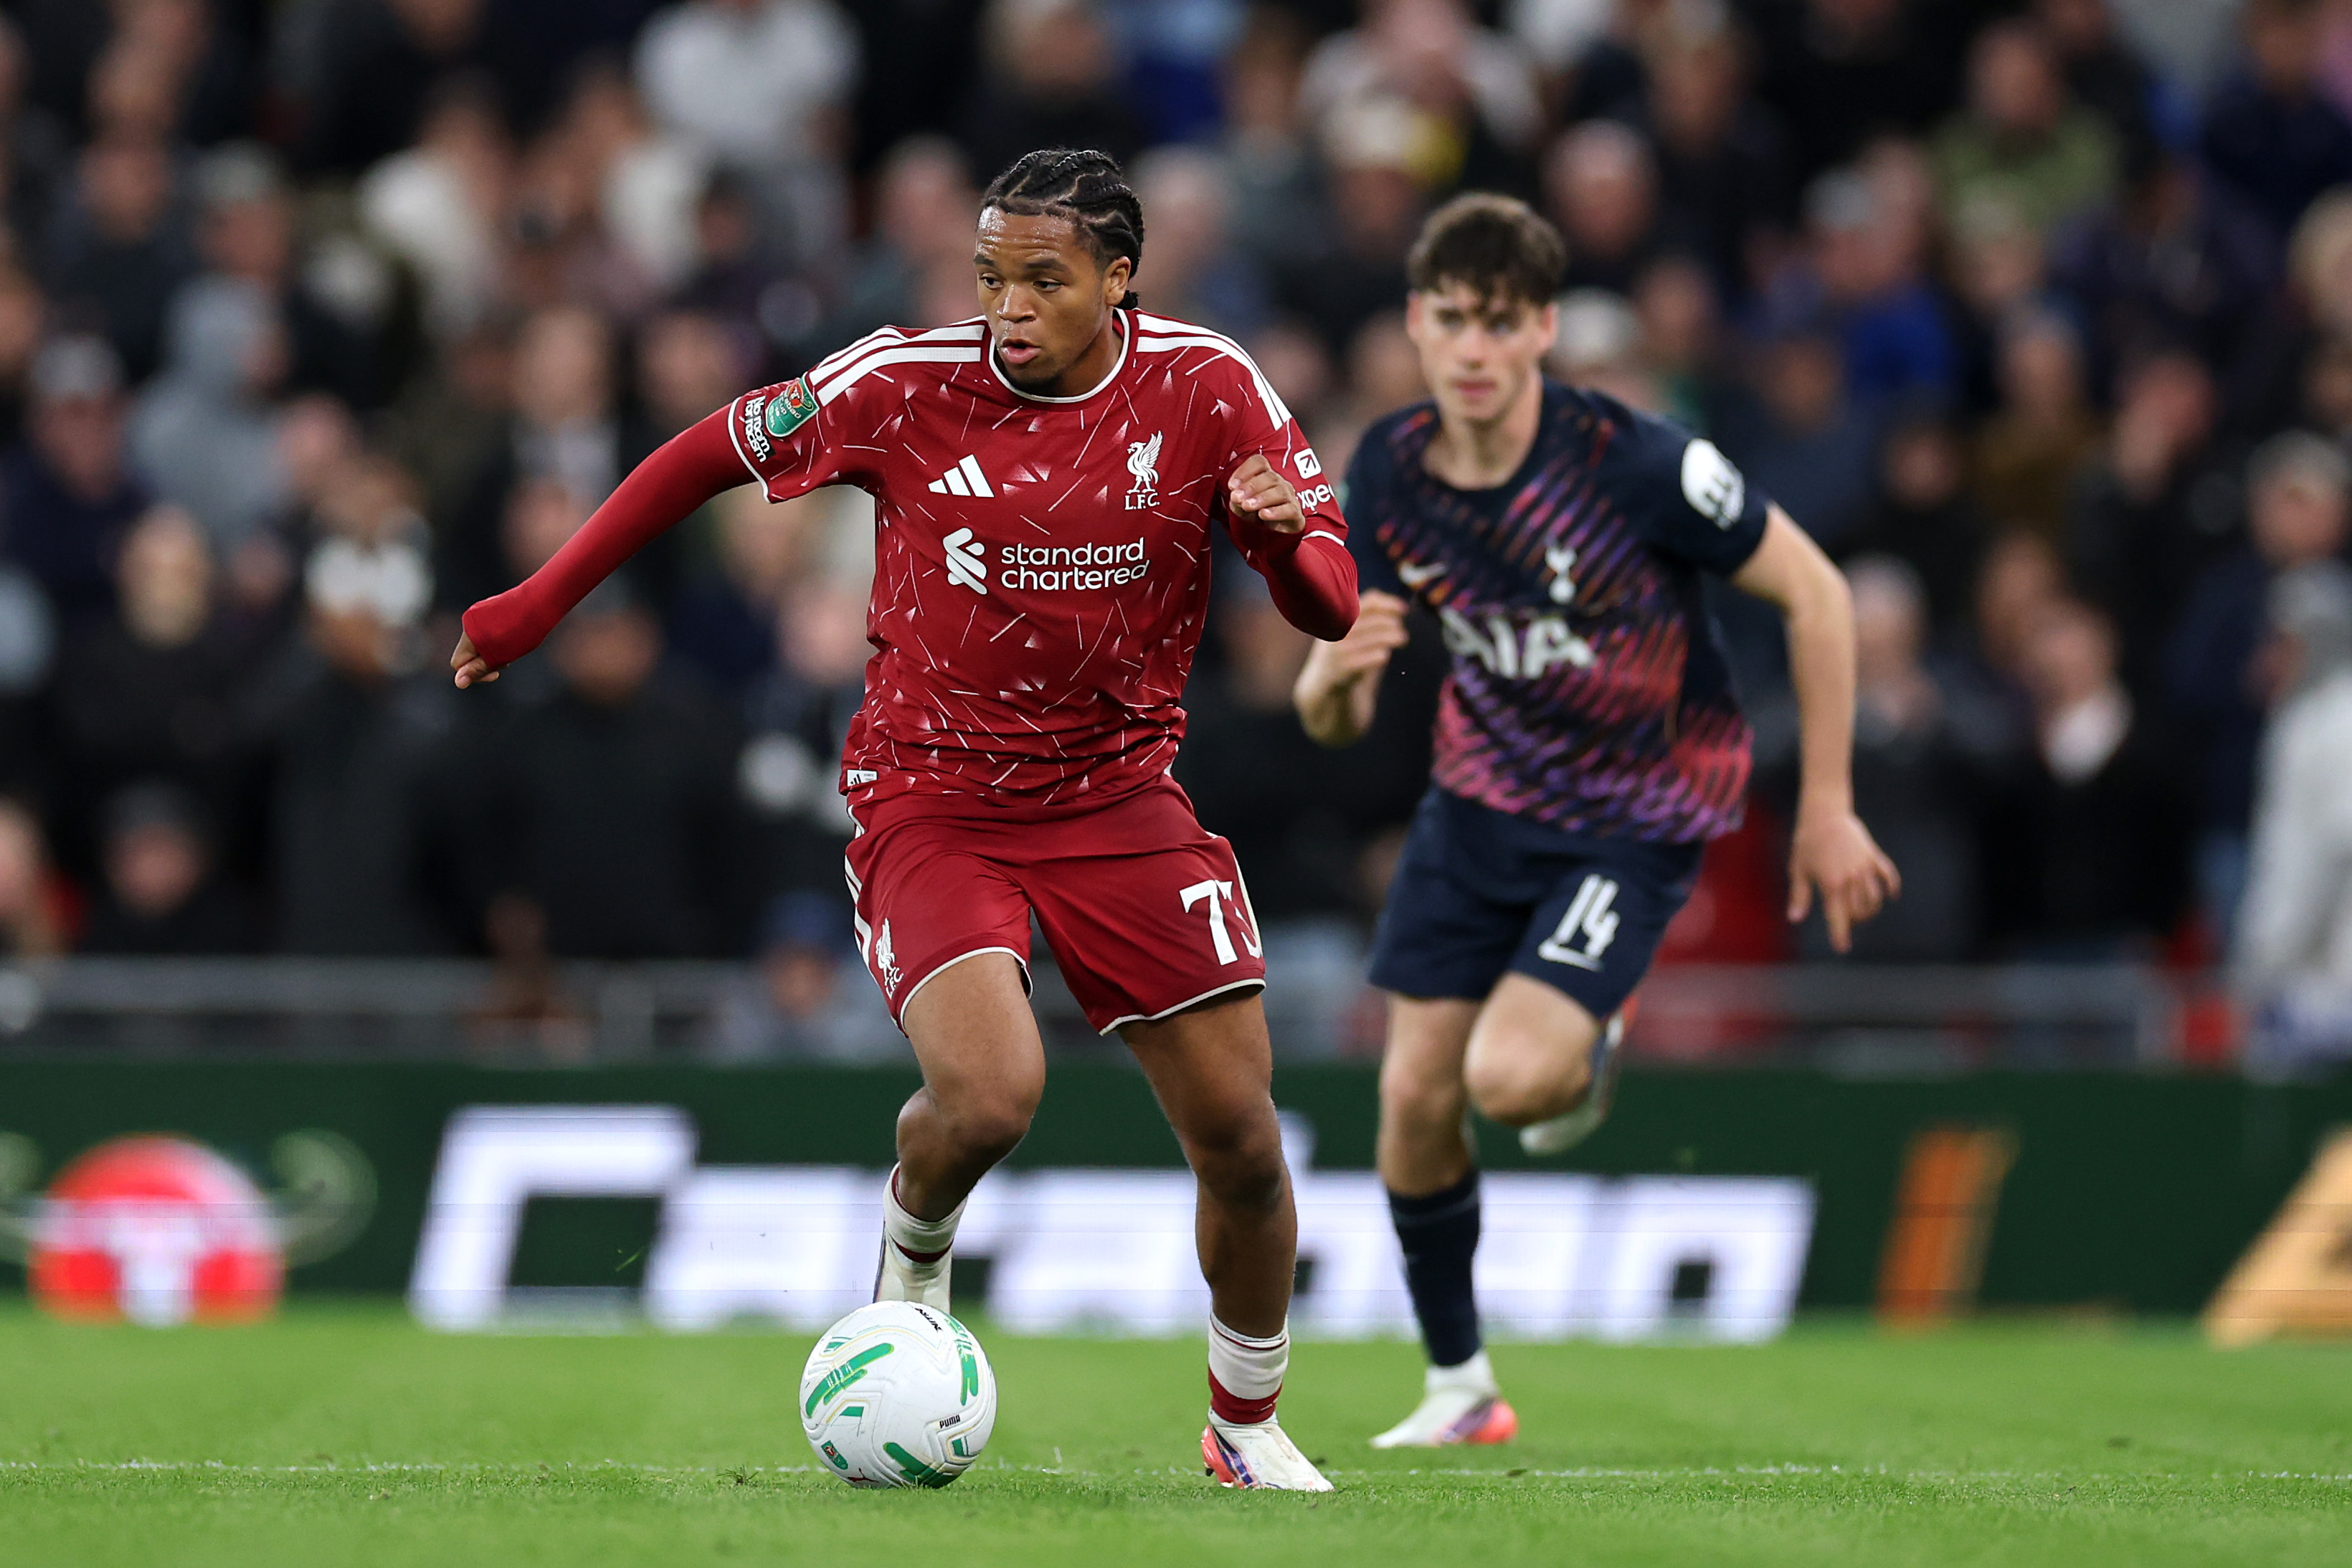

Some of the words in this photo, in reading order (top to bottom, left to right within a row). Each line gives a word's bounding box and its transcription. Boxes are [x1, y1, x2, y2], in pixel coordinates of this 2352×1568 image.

[745, 400, 754, 417] for
[751, 396, 767, 416] No
[745, 418, 767, 463] racism
[753, 415, 770, 452] room
[1295, 483, 1335, 511] xpe
[1001, 537, 1144, 566] standard
[1001, 559, 1150, 590] chartered
[1441, 607, 1596, 679] AIA
[1537, 873, 1621, 972] 14
[939, 1415, 961, 1429] PUMA
